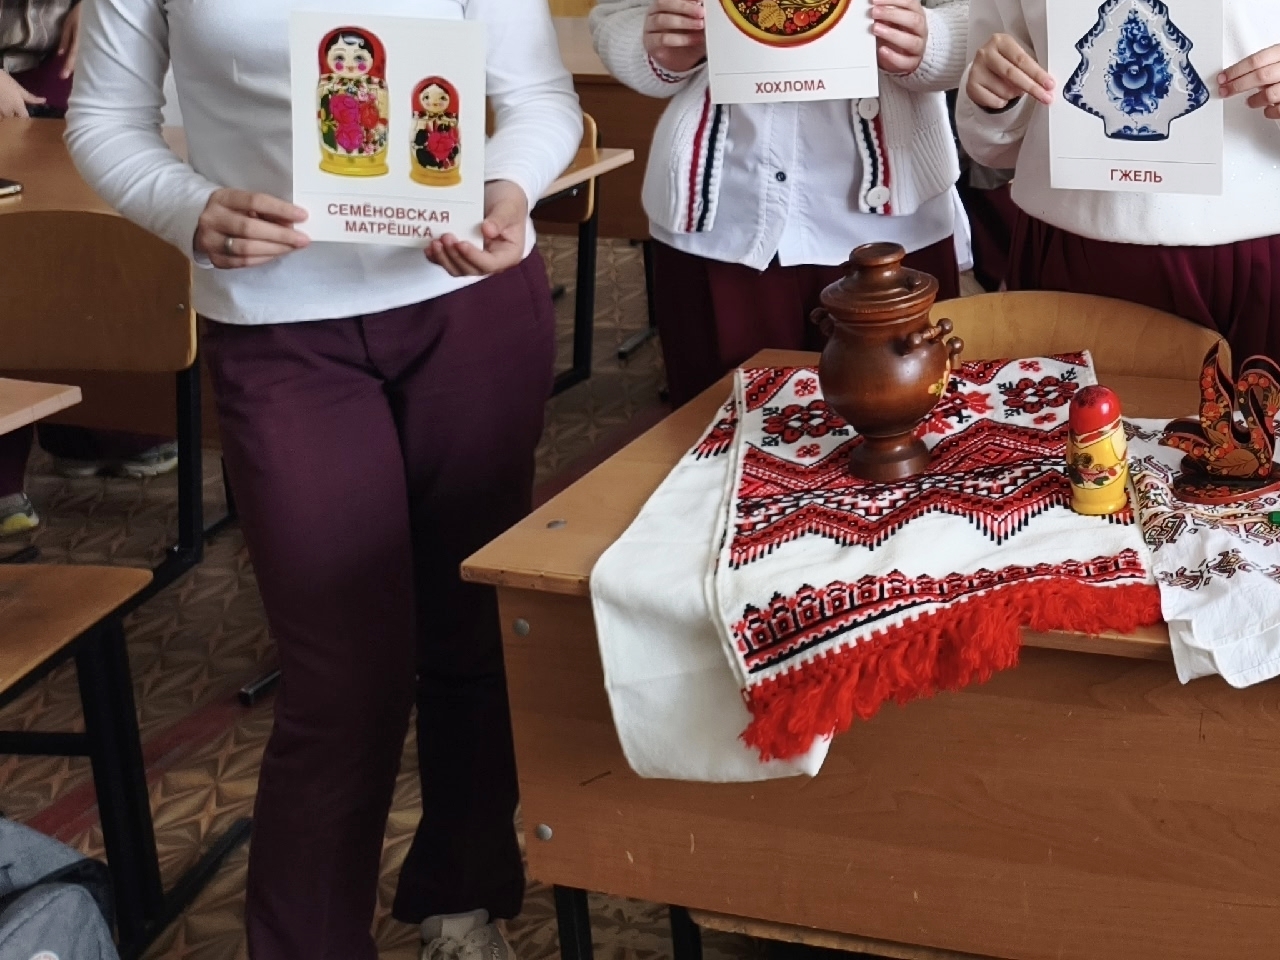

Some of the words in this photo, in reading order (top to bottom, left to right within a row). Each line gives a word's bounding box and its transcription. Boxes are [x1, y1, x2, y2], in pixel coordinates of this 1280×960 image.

[755, 79, 826, 94] ХОХЛОМА
[1110, 168, 1163, 183] ГЖЕЛЬ
[327, 202, 450, 223] СЕМЁНОВСКАЯ
[345, 220, 434, 238] МАТРЁШКА
